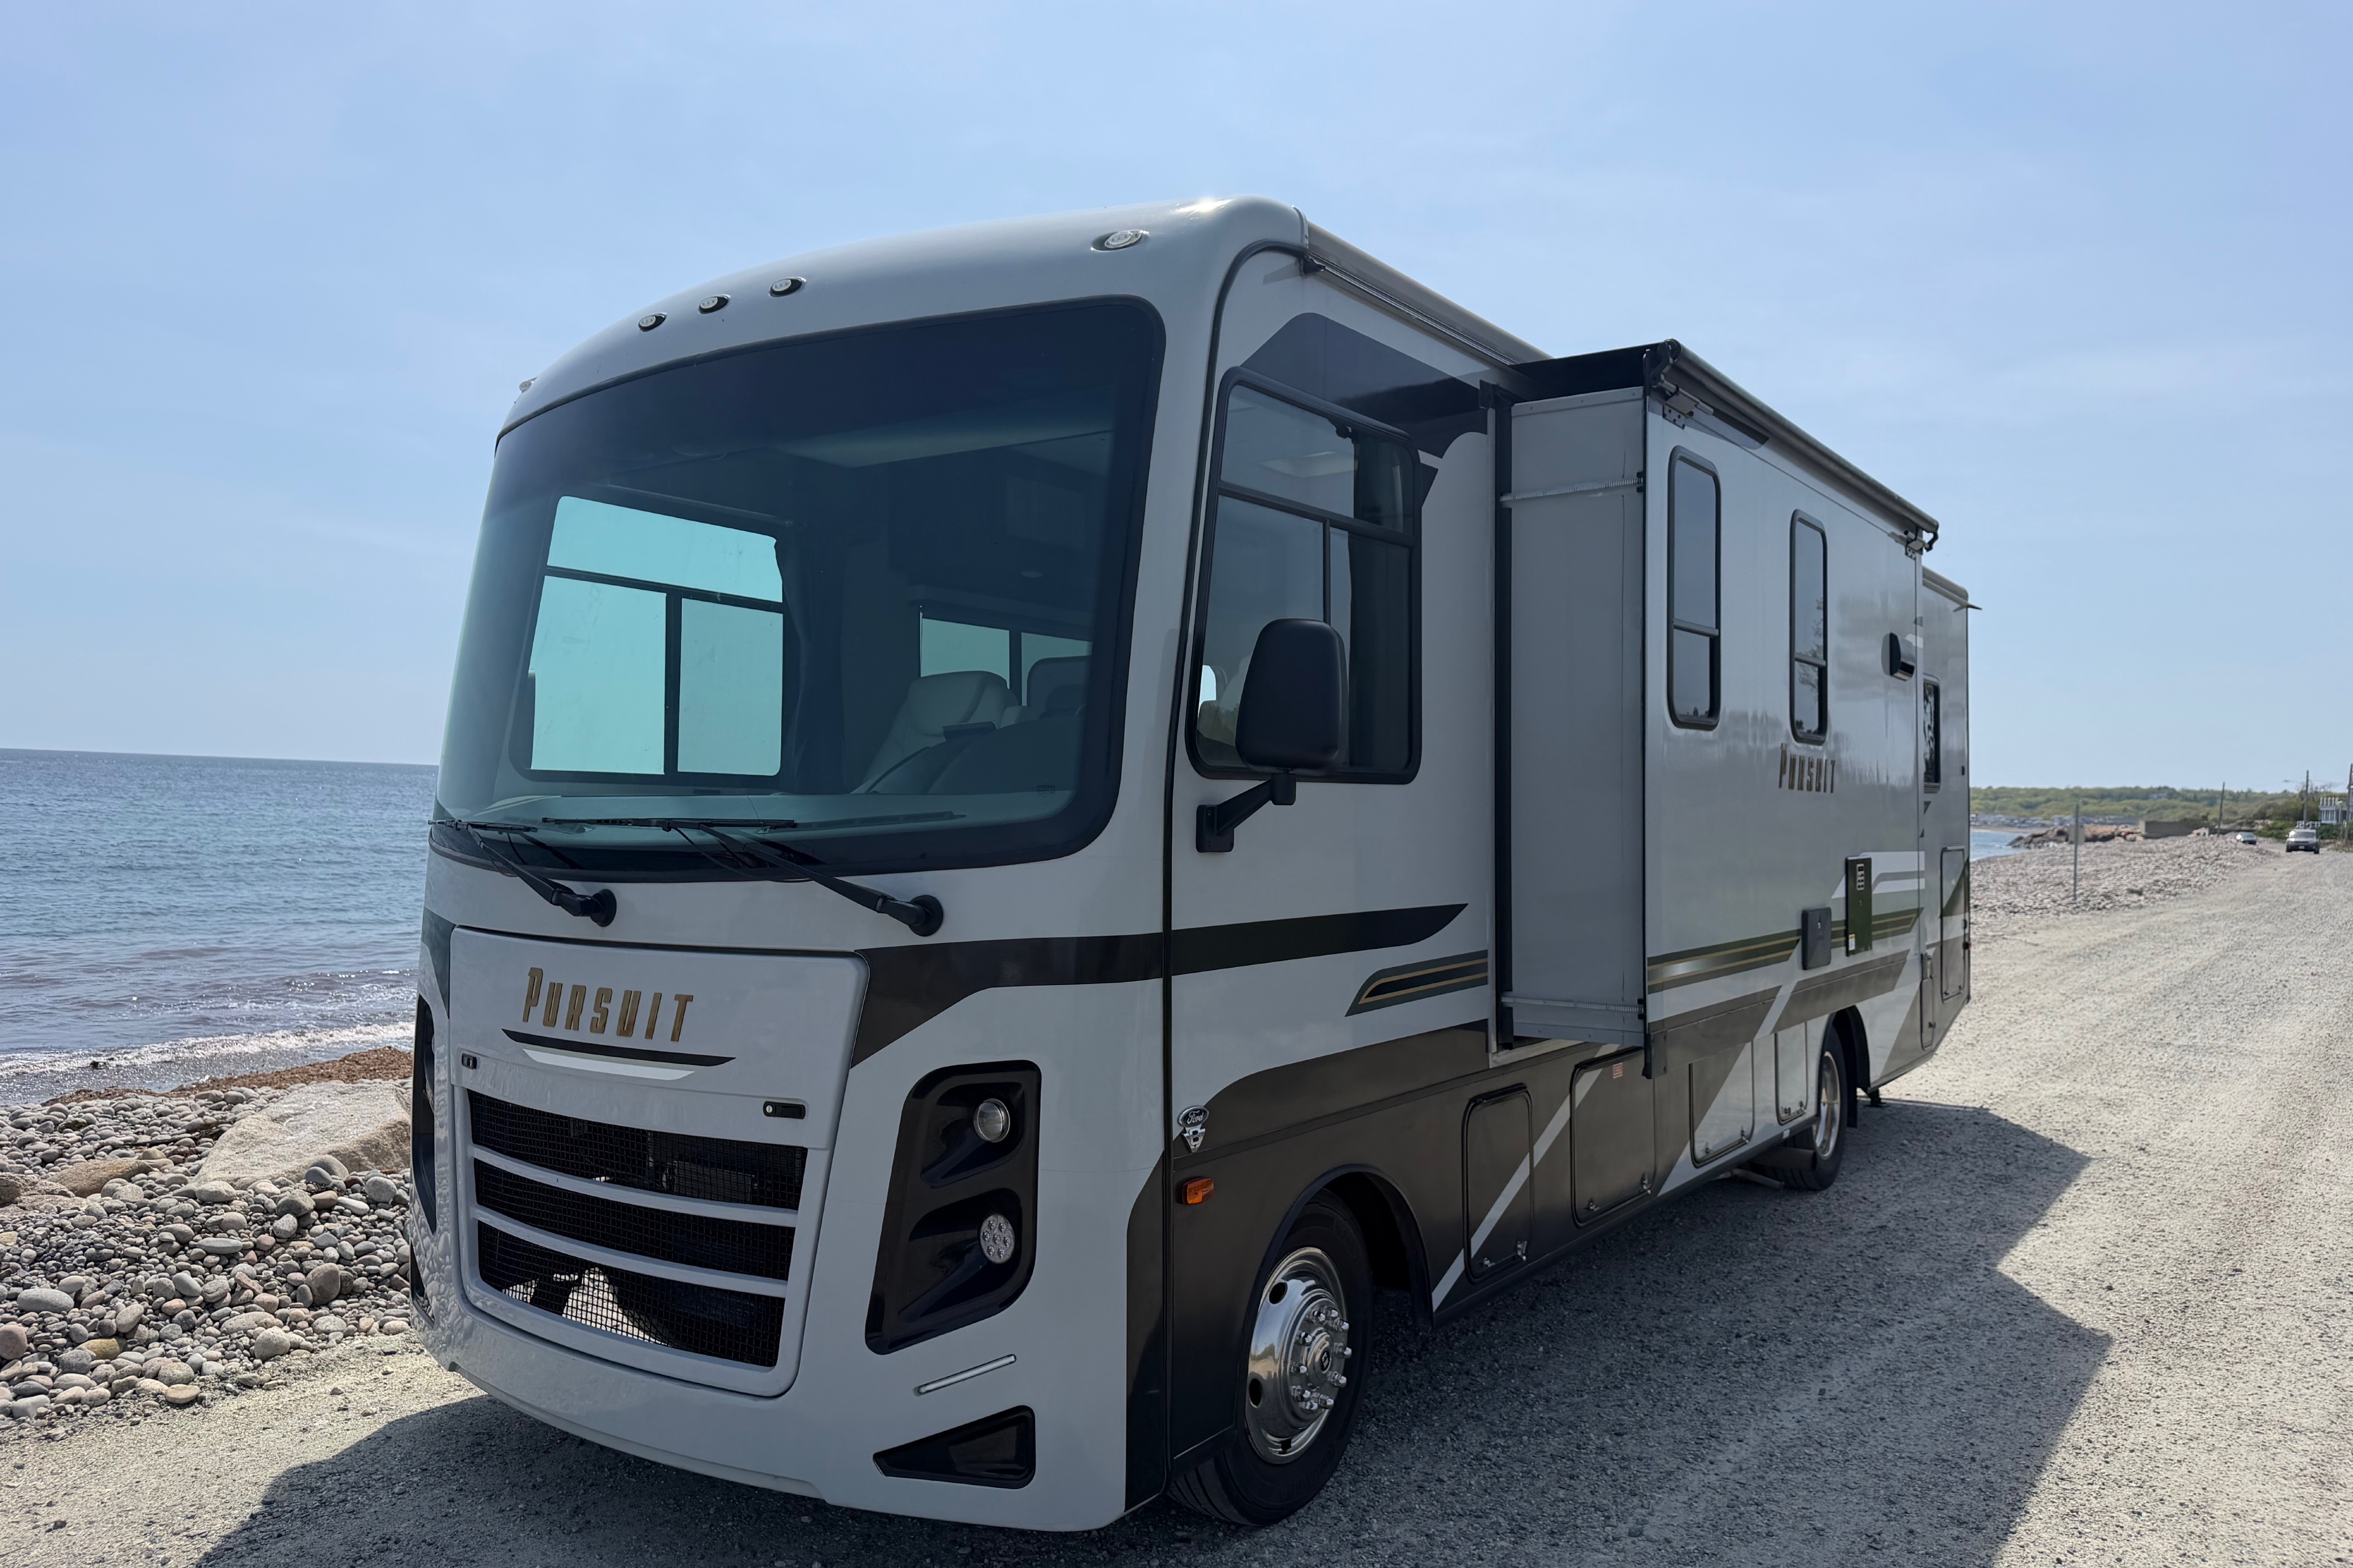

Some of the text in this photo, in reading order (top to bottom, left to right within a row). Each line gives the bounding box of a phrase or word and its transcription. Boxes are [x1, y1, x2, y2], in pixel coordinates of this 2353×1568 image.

[1779, 743, 1836, 793] PURSUIT
[522, 967, 694, 1042] PURSUIT
[1187, 1110, 1204, 1125] Ford
